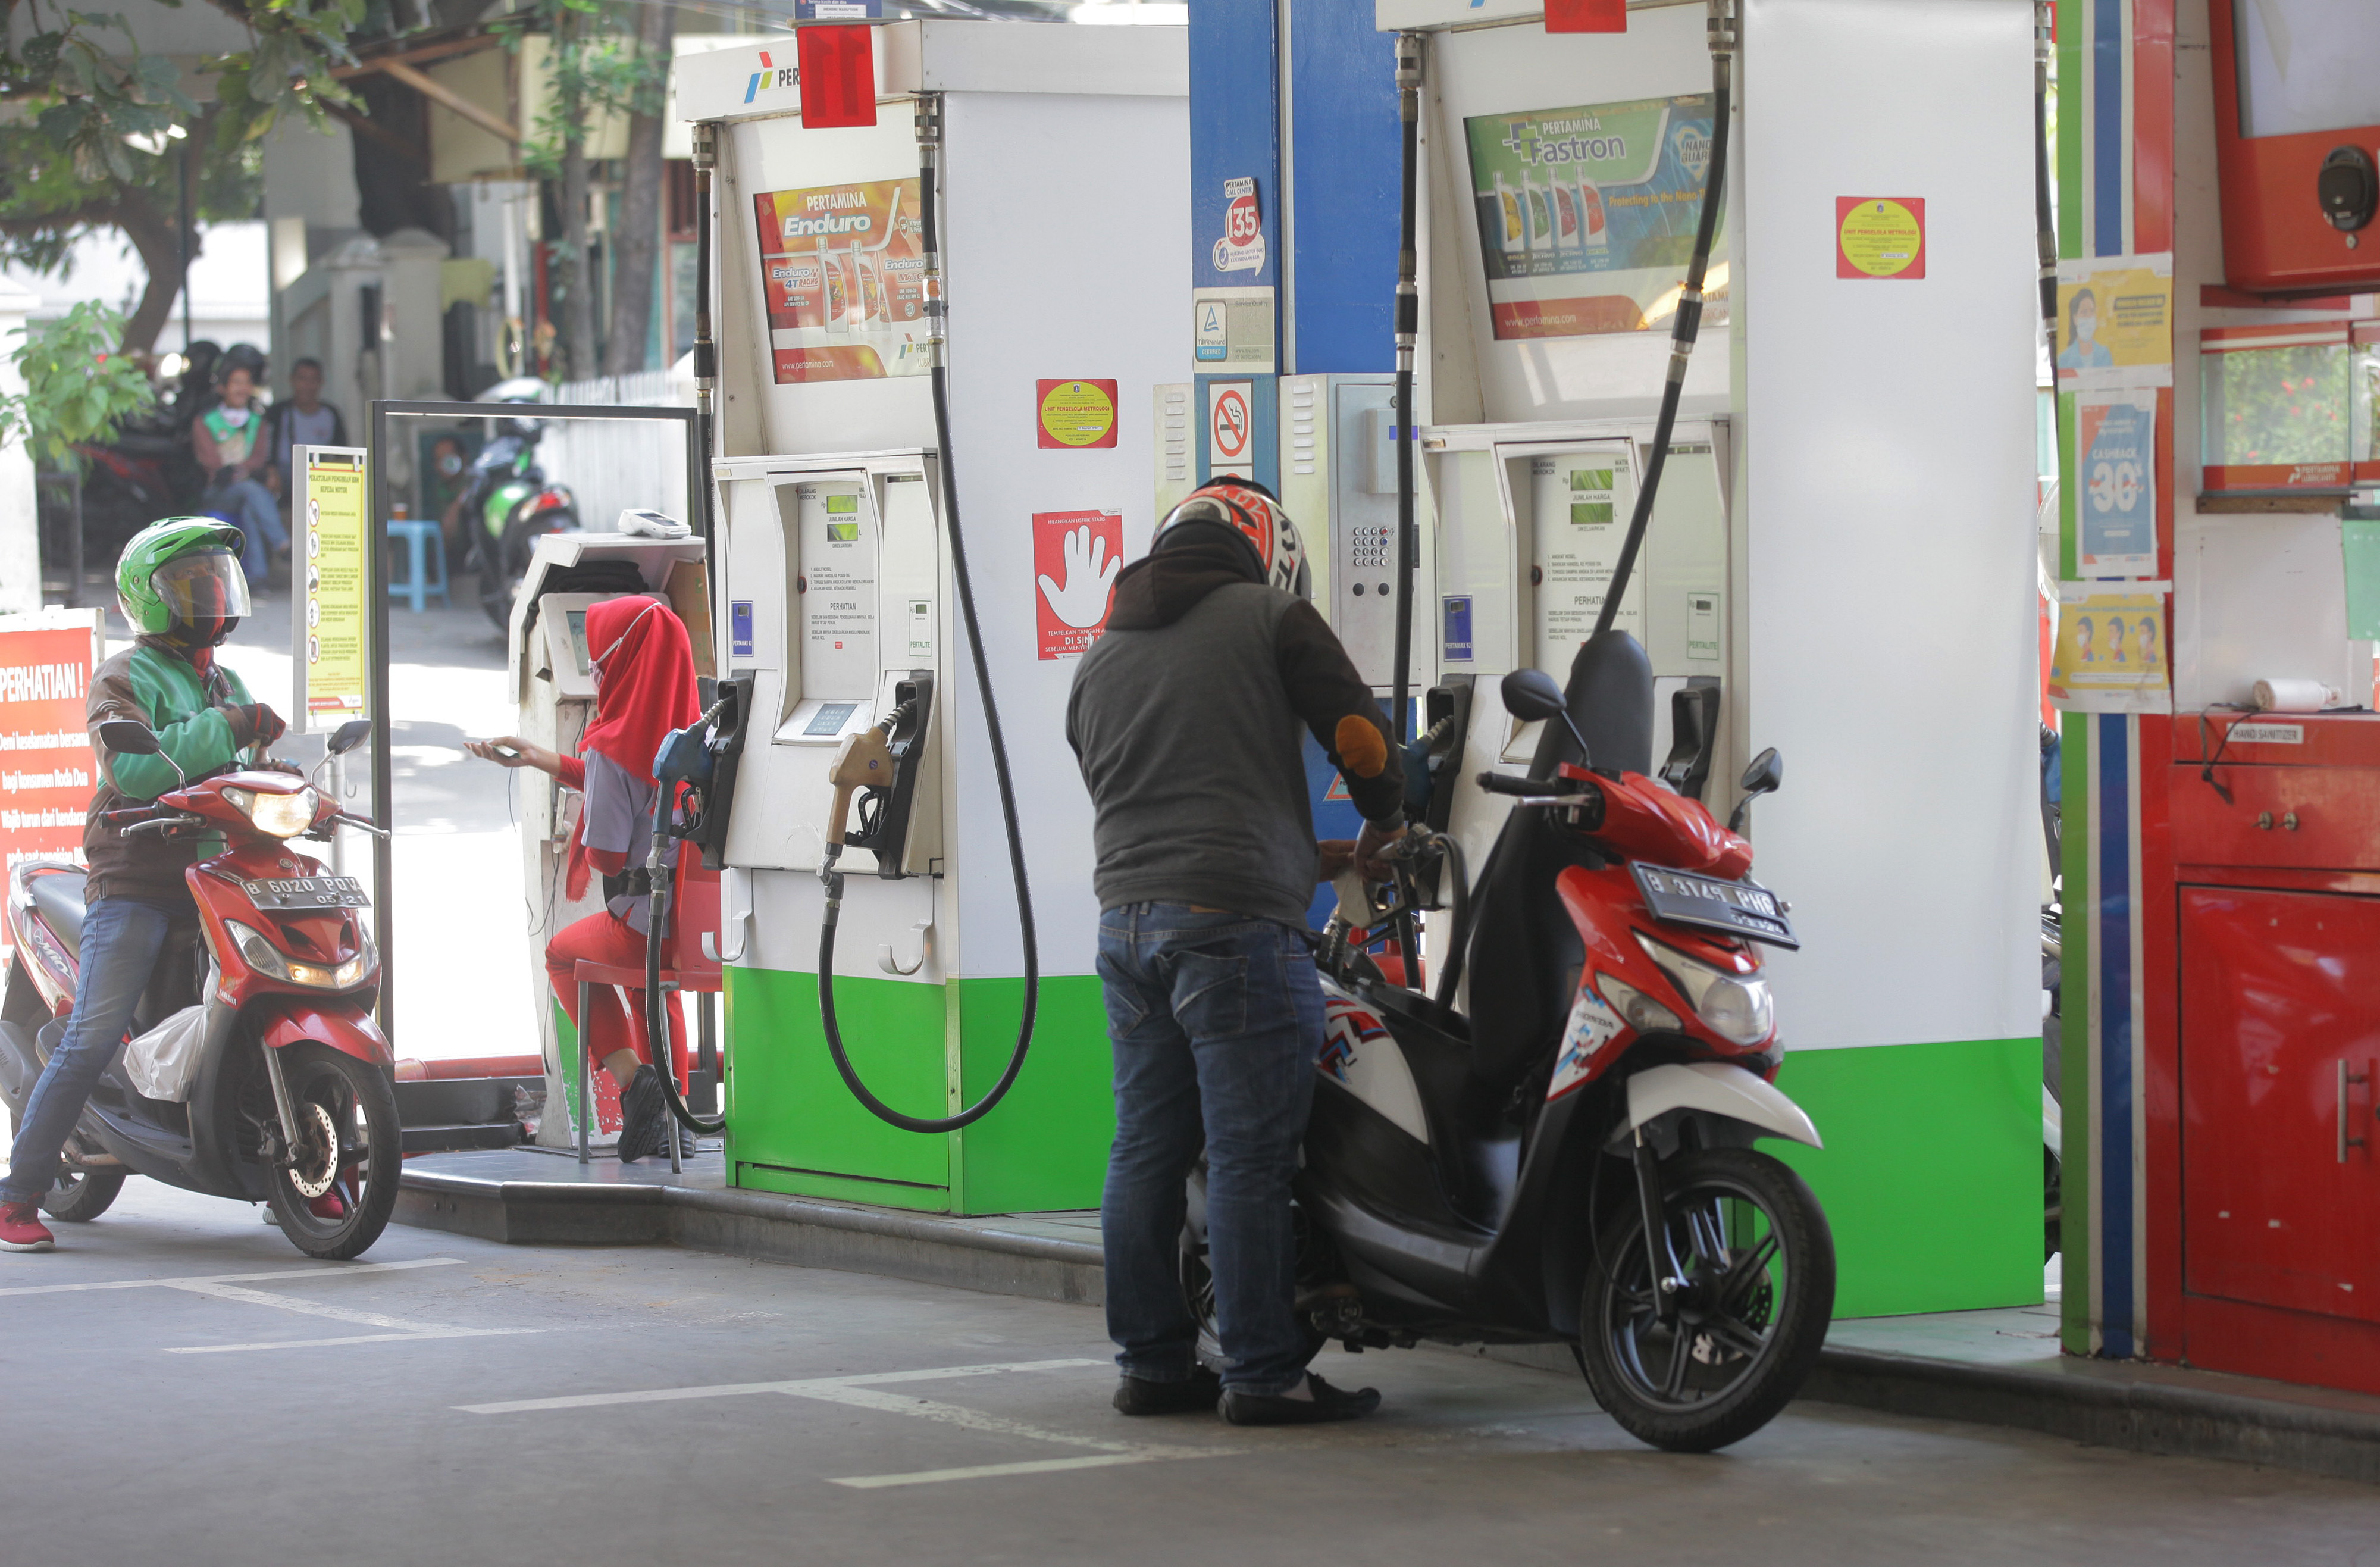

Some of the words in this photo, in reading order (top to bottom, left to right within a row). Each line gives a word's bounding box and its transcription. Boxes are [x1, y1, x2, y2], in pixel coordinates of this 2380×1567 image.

[1542, 118, 1601, 135] PERTAMINA
[1527, 136, 1626, 166] Fastron
[1226, 179, 1252, 189] PERTAMINA
[807, 192, 867, 211] PERTAMINA
[1609, 195, 1649, 207] Protecting
[1651, 195, 1658, 204] to
[1660, 192, 1673, 202] the
[1676, 191, 1696, 201] Nano
[783, 212, 872, 236] Enduro
[1229, 205, 1257, 238] 135
[884, 259, 923, 270] Enduro
[773, 267, 810, 279] Enduro
[785, 279, 798, 288] 4T
[799, 278, 818, 287] RACING
[1505, 314, 1577, 327] www.pertamina.com
[782, 361, 834, 371] www.pertamina.com
[2093, 448, 2137, 460] CASHBACK
[1689, 641, 1717, 649] PERTALITE
[0, 663, 76, 703] PERHATIAN
[78, 662, 84, 698] !
[15, 730, 60, 750] keselamatan
[60, 728, 90, 748] bersama
[2234, 729, 2255, 739] HAND
[2258, 729, 2297, 740] SANITIZER
[2, 770, 18, 794] bagi
[18, 770, 54, 789] konsumen
[54, 768, 73, 787] Roda
[73, 768, 89, 787] Dua
[1, 809, 21, 833] Wajib
[21, 811, 41, 828] turun
[41, 808, 55, 827] dari
[246, 883, 261, 895] B
[268, 879, 315, 893] 6020
[1646, 872, 1664, 893] B
[317, 896, 336, 904] 05
[346, 896, 365, 904] 21
[1577, 1011, 1614, 1029] HONDA
